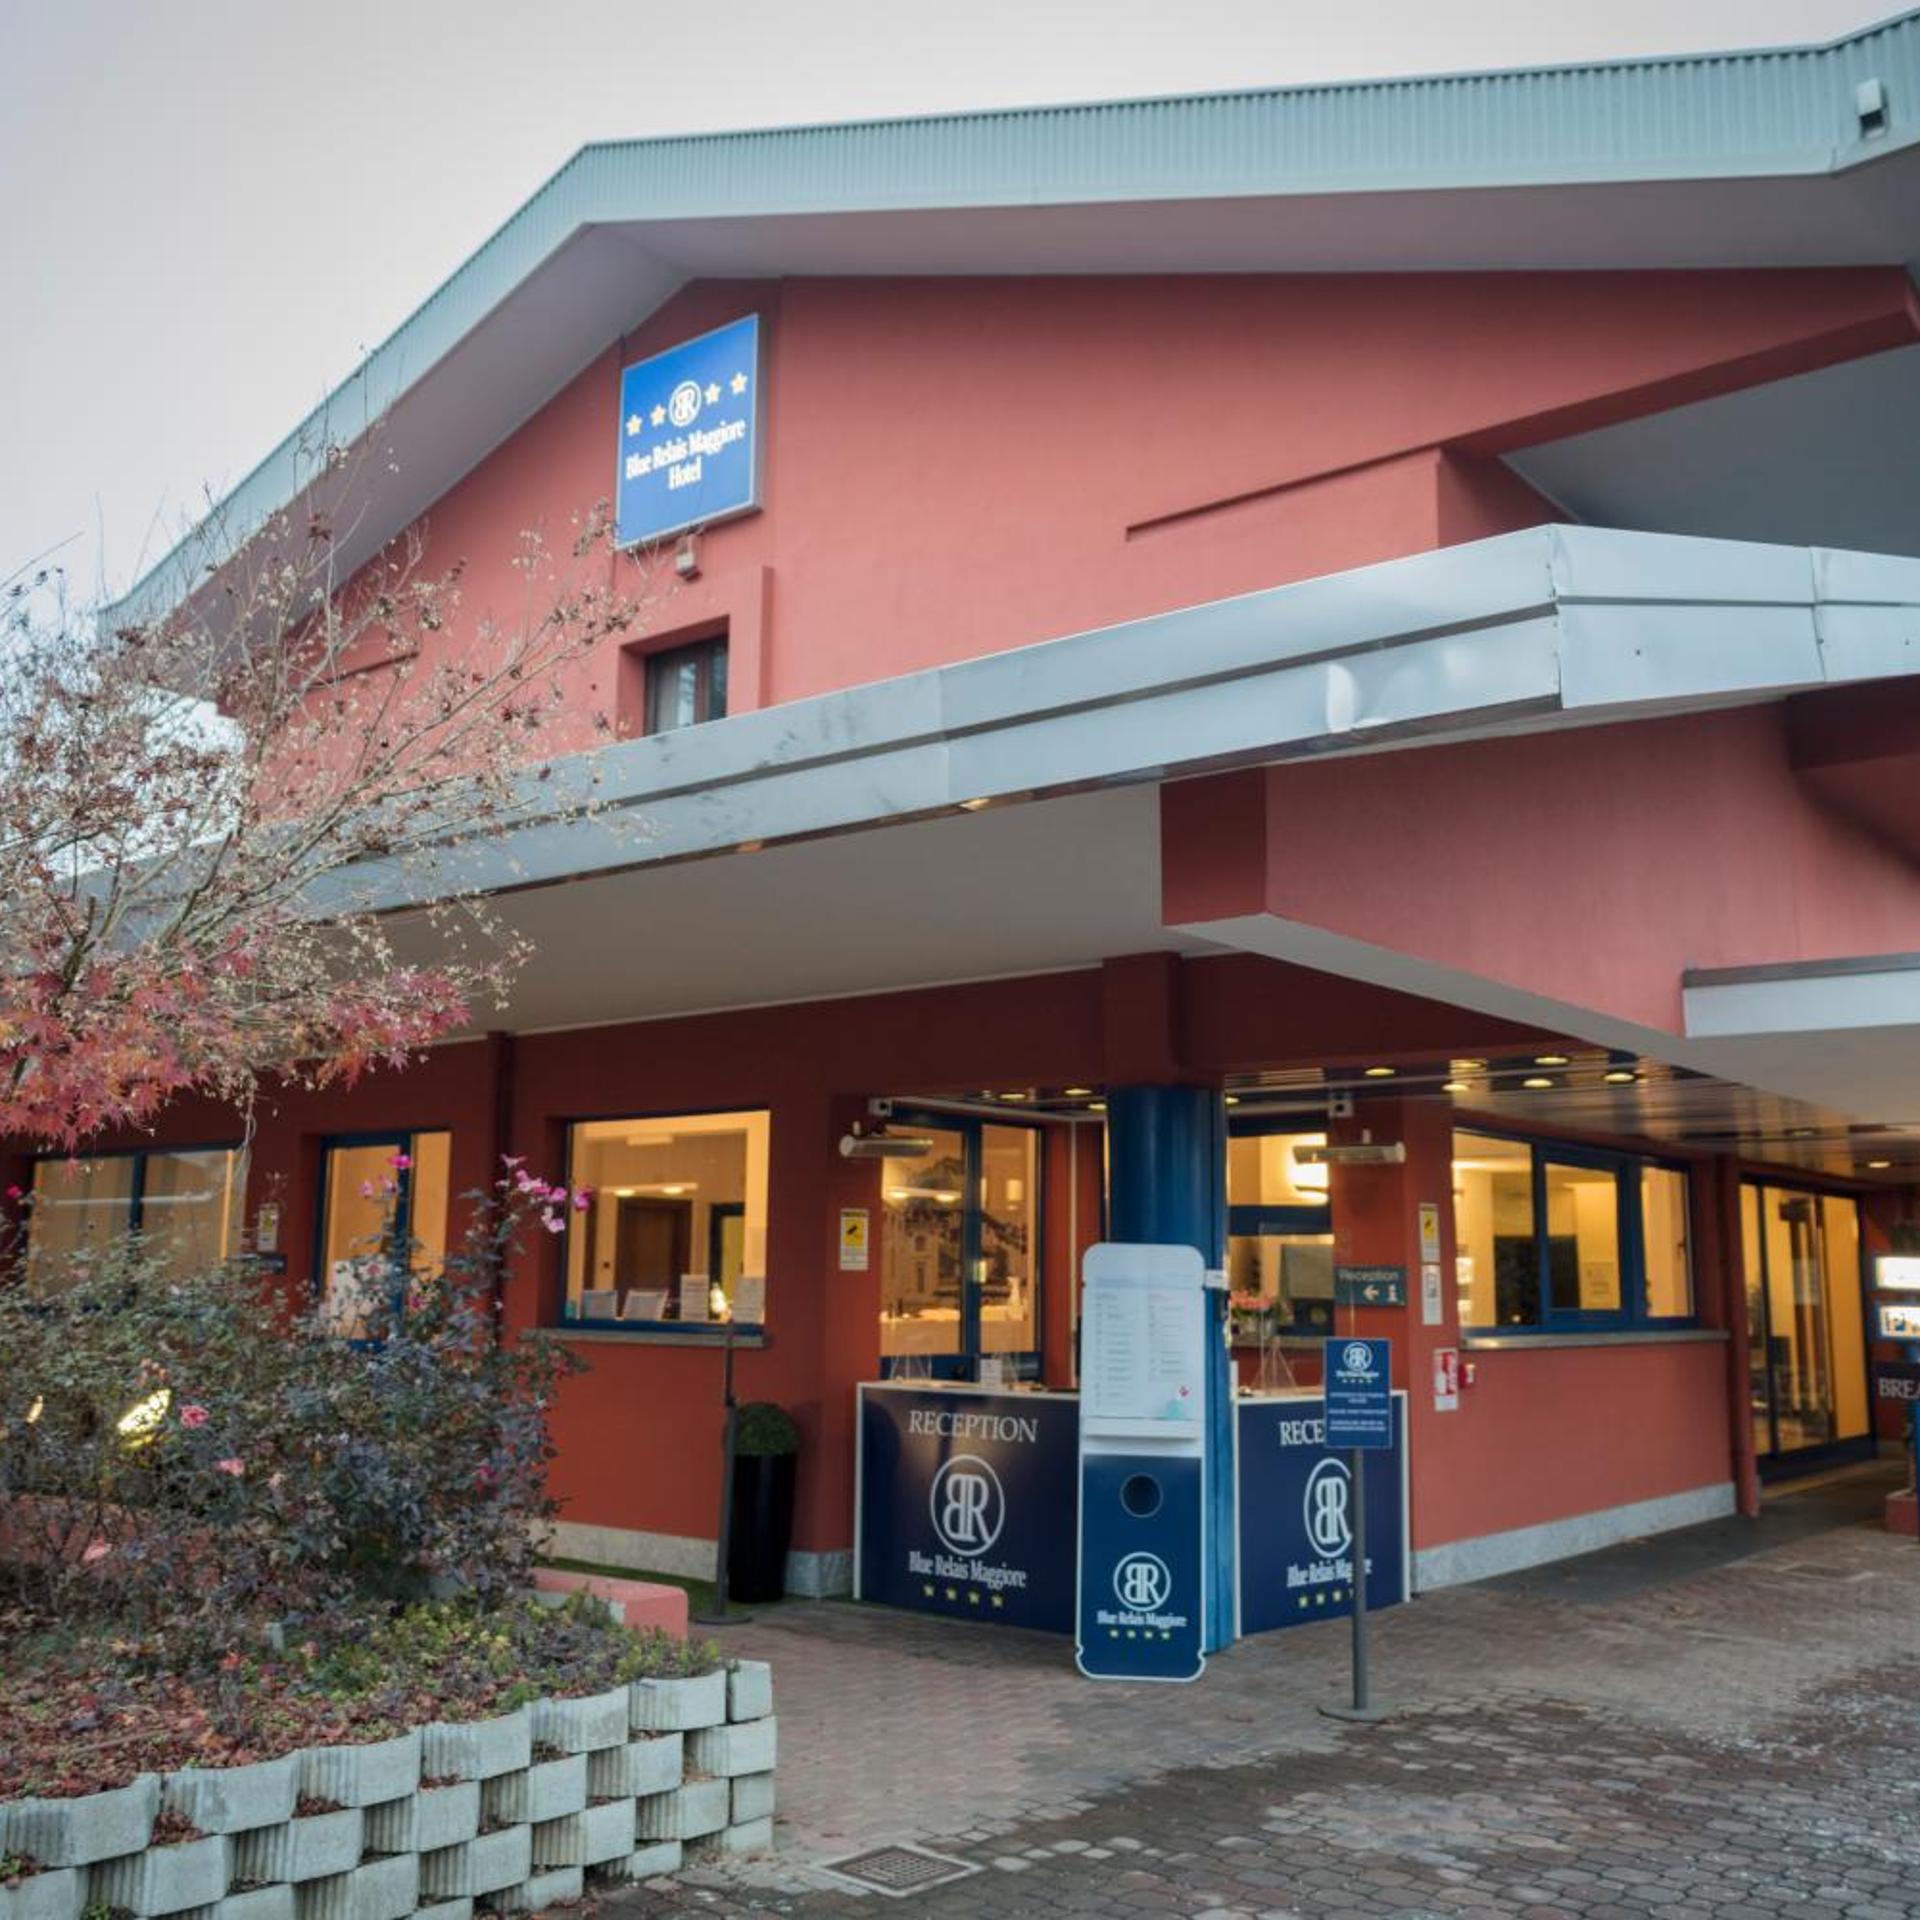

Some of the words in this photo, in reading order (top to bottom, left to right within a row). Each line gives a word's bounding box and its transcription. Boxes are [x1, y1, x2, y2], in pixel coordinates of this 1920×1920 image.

[668, 455, 702, 490] Hotel
[1338, 1268, 1399, 1282] Reception
[908, 1409, 1039, 1443] RECEPTION
[1279, 1418, 1325, 1446] RECE
[909, 1551, 934, 1575] Blue
[934, 1554, 968, 1580] Relais
[970, 1559, 1027, 1590] Maggiore
